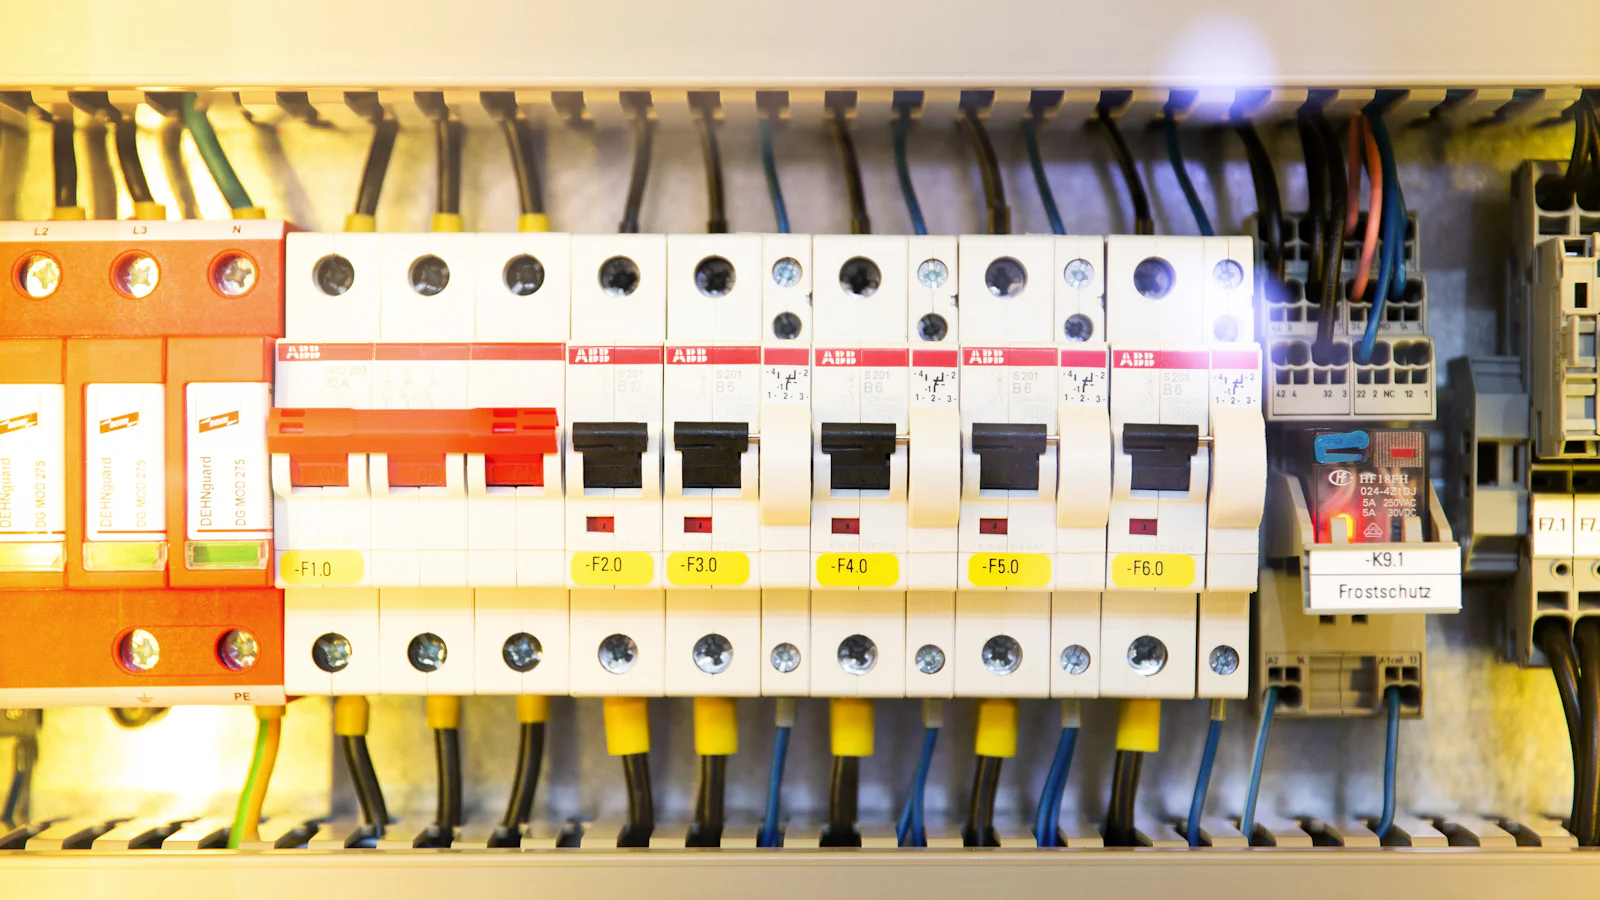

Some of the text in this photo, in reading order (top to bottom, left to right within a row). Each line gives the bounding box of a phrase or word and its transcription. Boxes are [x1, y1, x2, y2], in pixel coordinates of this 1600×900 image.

[34, 227, 48, 236] L2
[133, 226, 148, 235] L3
[232, 225, 241, 234] N
[286, 346, 320, 358] ABB
[575, 348, 610, 362] ABB
[672, 348, 708, 362] ABB
[822, 350, 856, 364] ABB
[970, 350, 1004, 364] ABB
[1120, 352, 1154, 366] ABB
[1276, 390, 1286, 398] 42
[1292, 390, 1297, 398] 4
[1324, 390, 1332, 398] 32
[1342, 390, 1348, 398] 3
[1356, 390, 1366, 398] 22
[1373, 390, 1378, 398] 2
[1384, 390, 1395, 398] NC
[1405, 390, 1413, 398] 12
[1424, 390, 1428, 398] 1
[1360, 474, 1408, 484] HF18FH
[0, 458, 14, 528] DEHNguard
[34, 460, 46, 528] DG MOD 275
[100, 457, 114, 527] DEHNguard
[136, 460, 146, 527] DG MOD 275
[200, 456, 214, 526] DEHNguard
[234, 459, 246, 526] DG MOD 275
[1362, 499, 1417, 507] 5A 250VAC
[1362, 508, 1417, 517] 5A 30VDC
[1539, 517, 1565, 531] F7.1
[586, 556, 622, 573] -F2.0
[680, 557, 717, 573] -F3.0
[831, 558, 868, 574] -F4.0
[982, 558, 1019, 574] -F5.0
[1365, 552, 1404, 567] -K9.1
[295, 561, 332, 578] -F1.0
[1127, 560, 1164, 576] -F6.0
[1339, 584, 1431, 599] Frostschutz
[234, 692, 251, 700] PE
